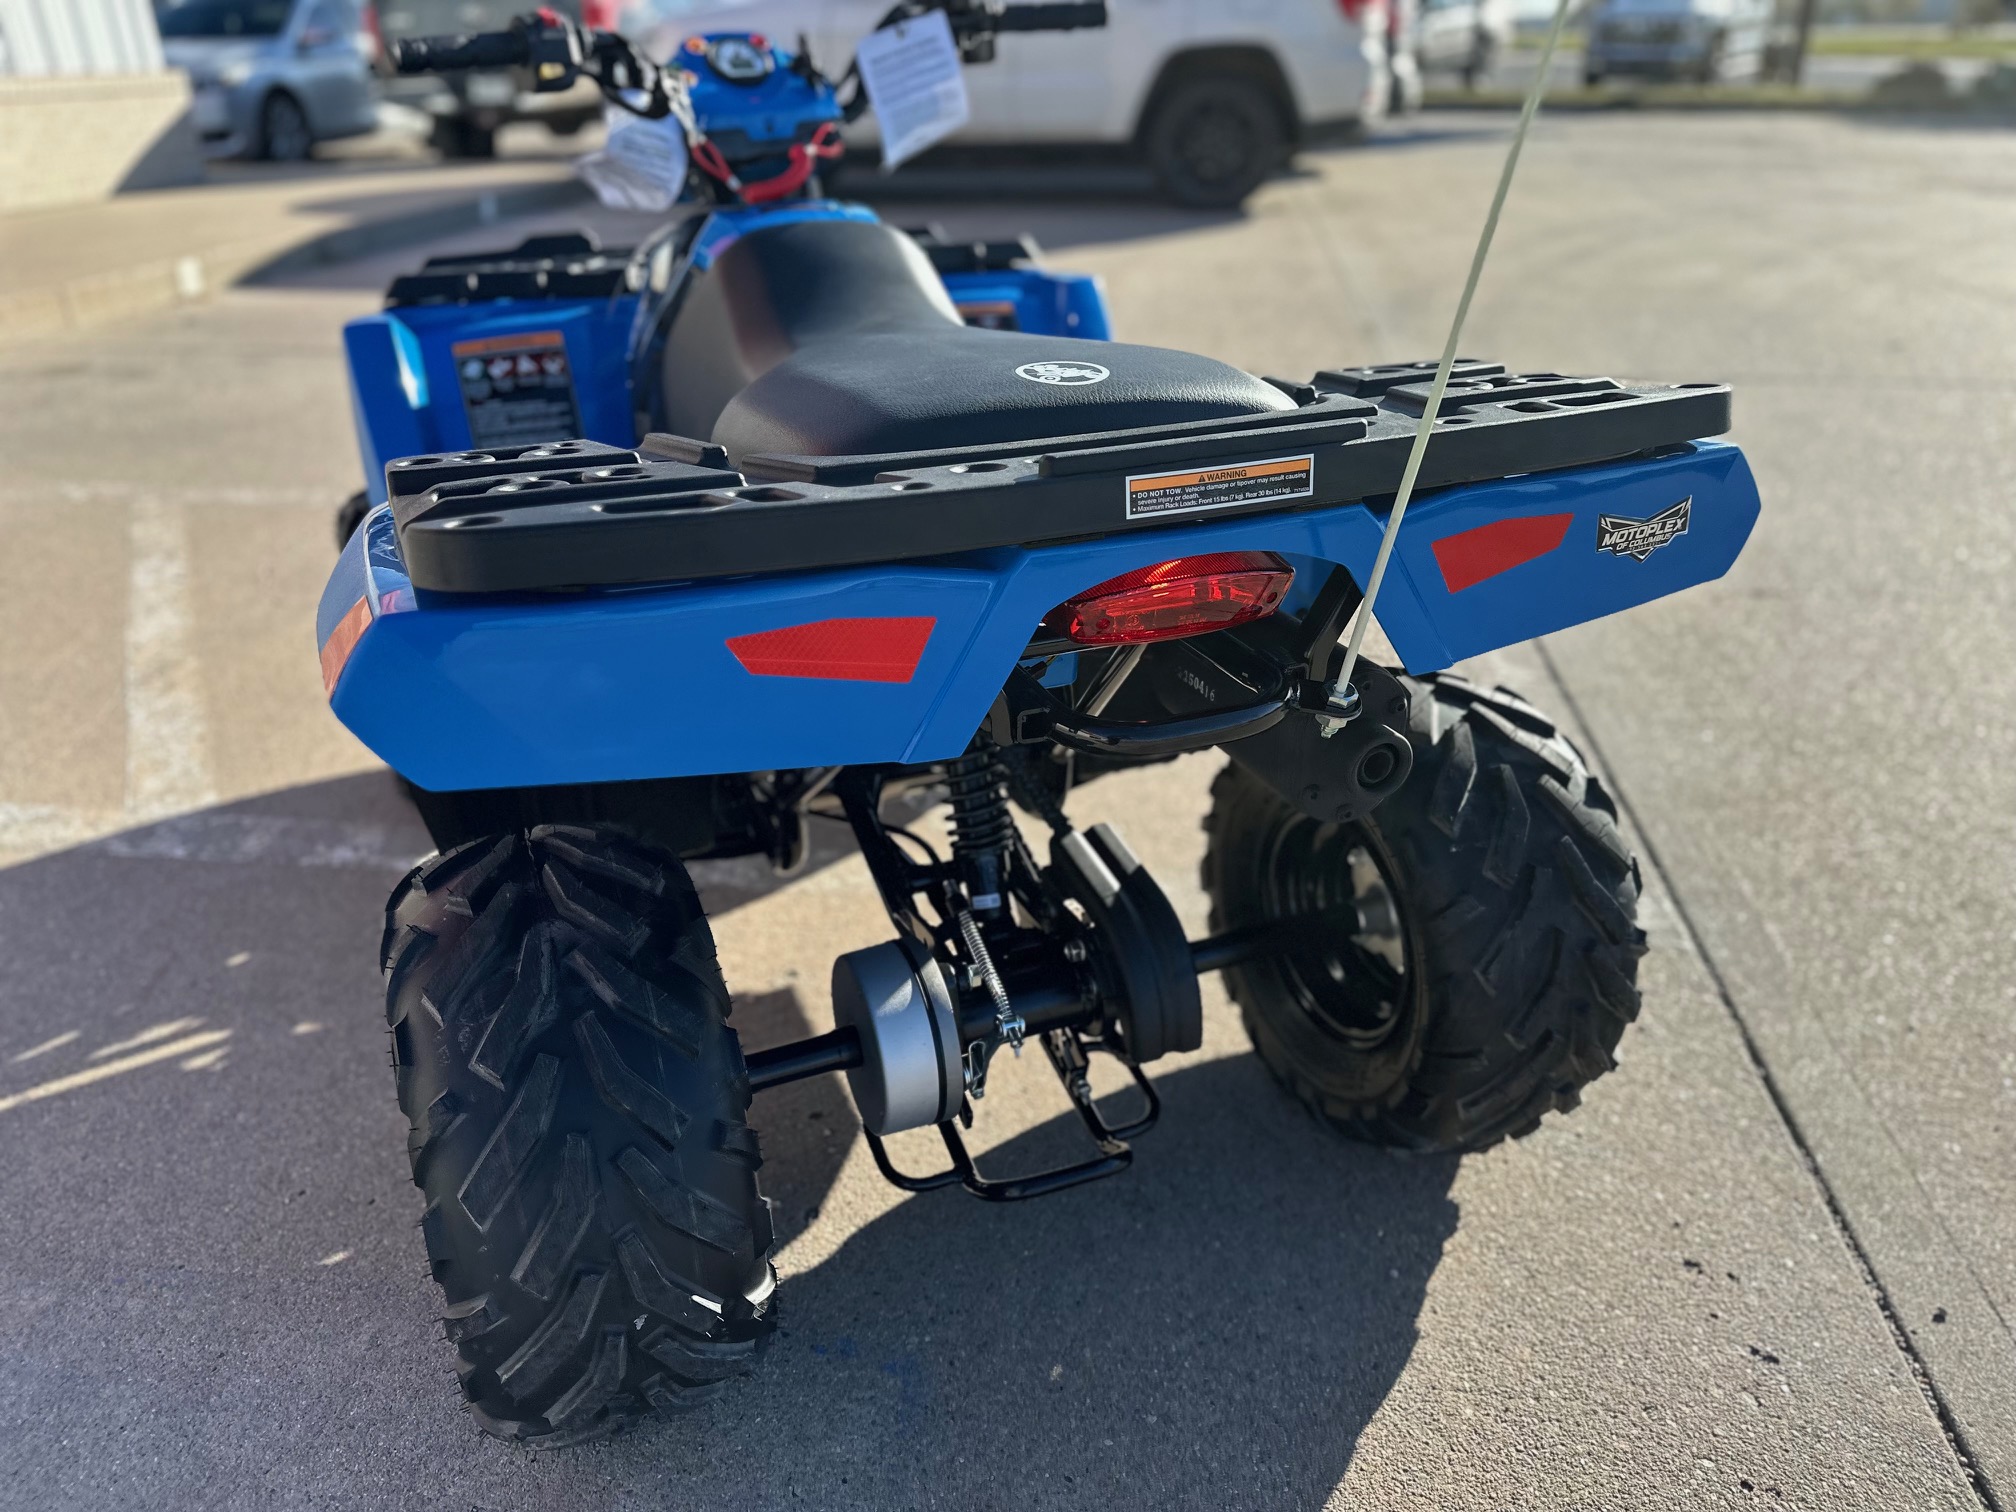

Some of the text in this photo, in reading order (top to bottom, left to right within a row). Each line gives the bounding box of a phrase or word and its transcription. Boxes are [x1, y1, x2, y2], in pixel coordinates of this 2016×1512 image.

[1206, 469, 1247, 481] WARNING
[1138, 504, 1164, 512] Maximum
[1601, 517, 1686, 546] MOTOPLEX
[1616, 542, 1630, 550] OF
[1628, 532, 1672, 548] COLUMBUS
